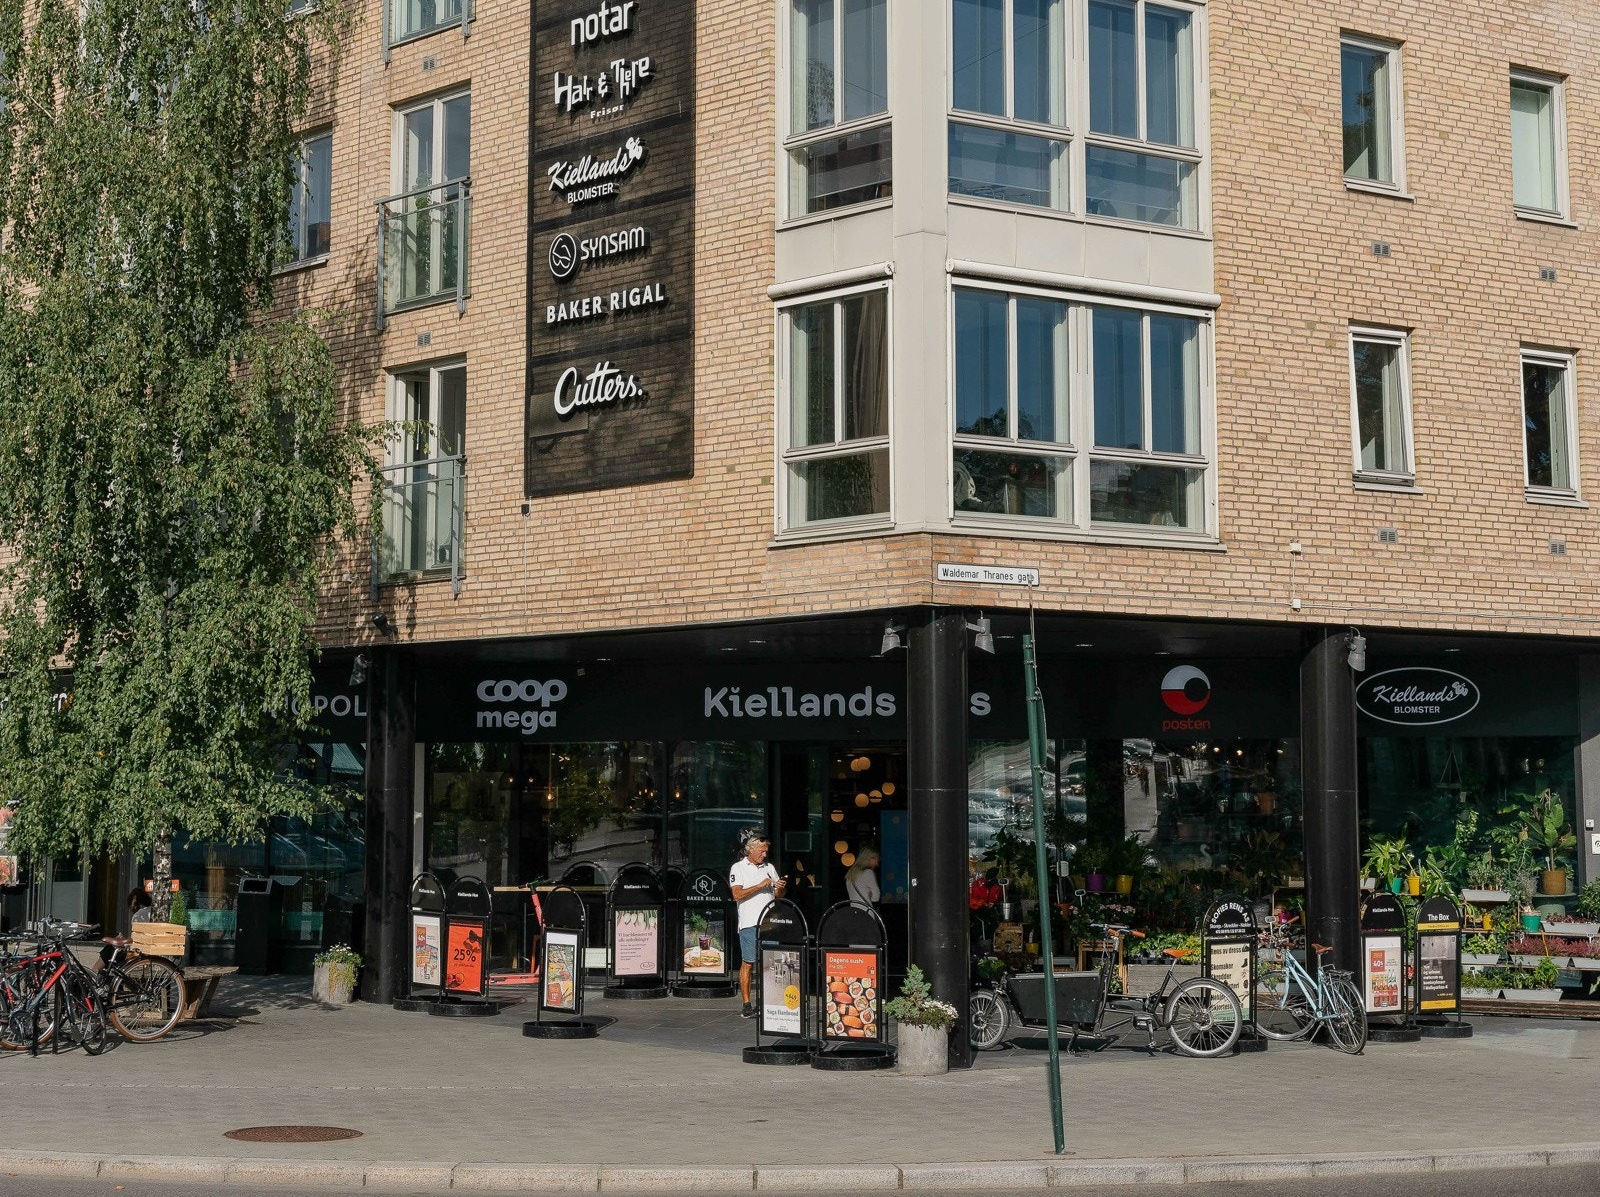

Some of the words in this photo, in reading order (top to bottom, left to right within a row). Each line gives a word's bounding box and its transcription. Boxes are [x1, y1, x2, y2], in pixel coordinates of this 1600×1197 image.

[571, 1, 633, 45] notar
[590, 104, 625, 119] Frisør
[548, 150, 632, 191] Kiellands
[567, 182, 614, 204] BLOMSTER
[546, 296, 603, 324] BAKER
[610, 282, 664, 310] RIGAL
[942, 568, 979, 579] Waldemar
[983, 570, 1014, 581] Thranes
[1017, 573, 1035, 583] gate
[476, 679, 568, 709] coop
[704, 686, 897, 718] Kiellands
[1373, 685, 1455, 703] Kiellands
[1394, 706, 1440, 714] BLOMSTER
[476, 710, 557, 735] mega
[1162, 718, 1212, 732] posten
[730, 874, 735, 882] 3
[1211, 903, 1229, 923] SOFIES
[1229, 902, 1244, 913] RENS
[1242, 912, 1250, 923] AS
[1439, 913, 1450, 921] Box
[454, 948, 477, 963] 25%
